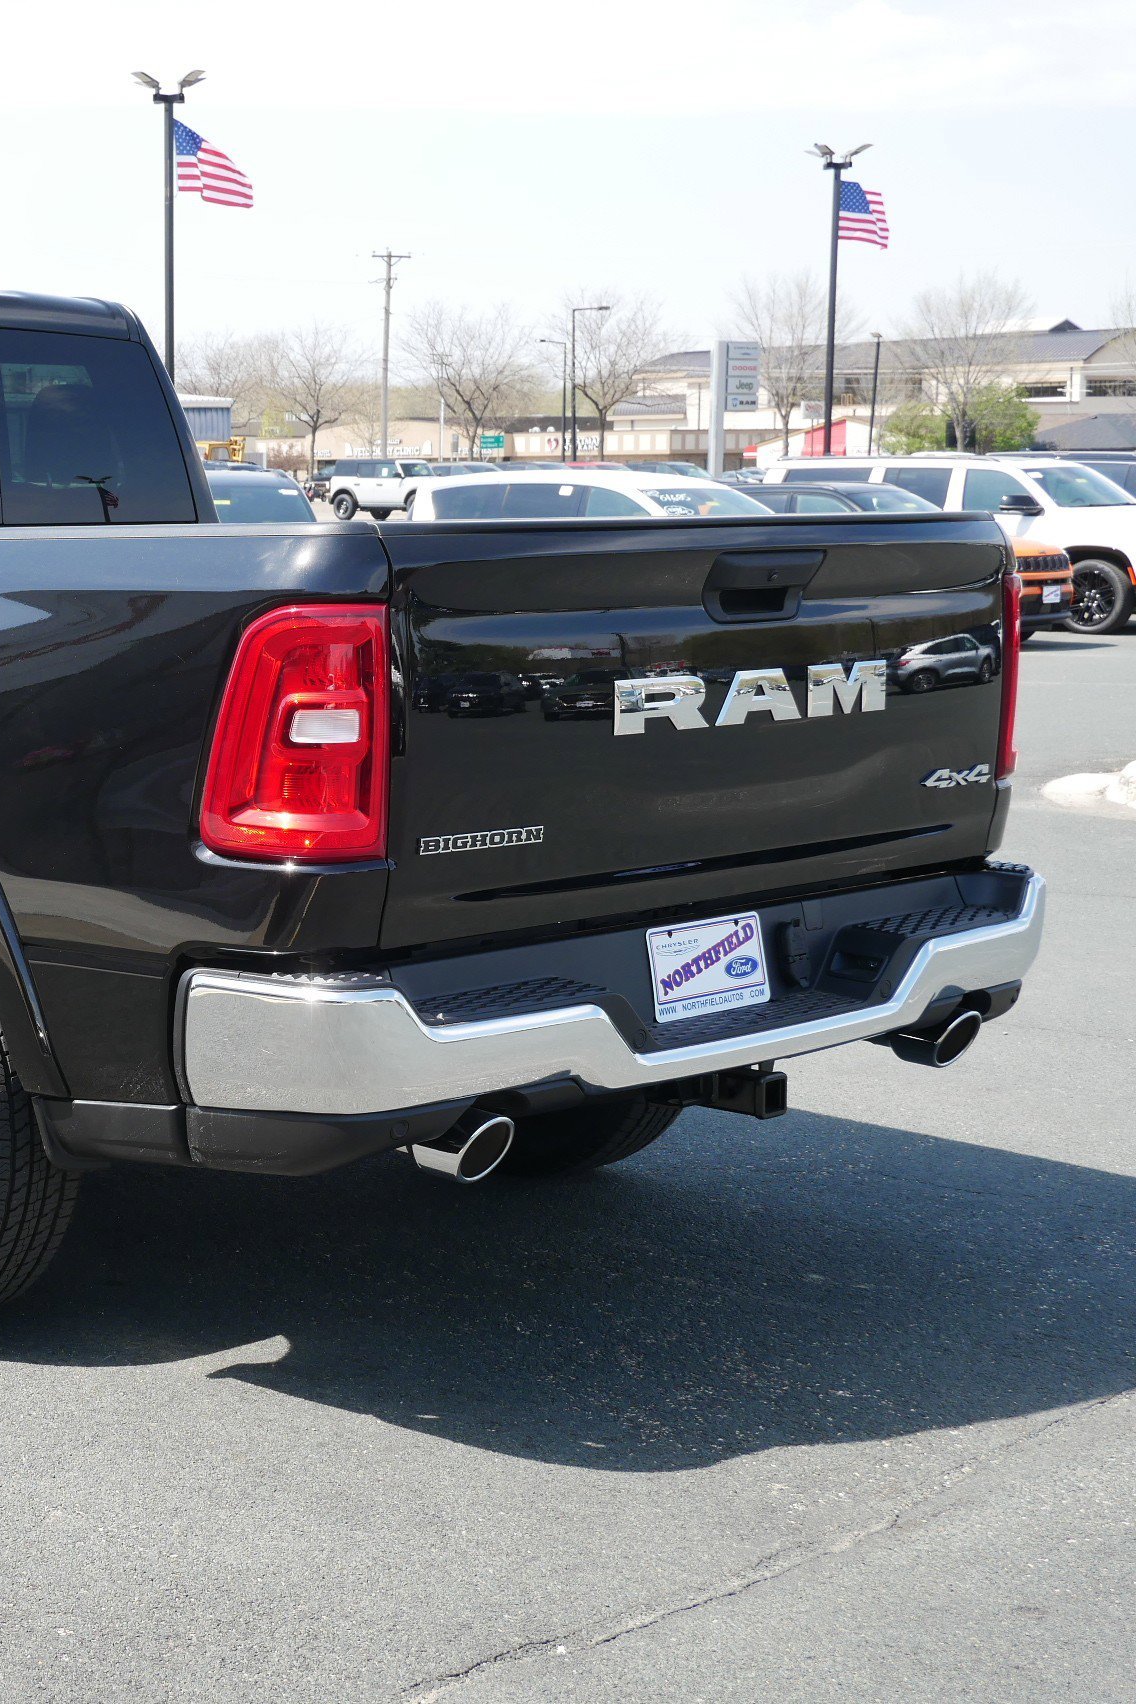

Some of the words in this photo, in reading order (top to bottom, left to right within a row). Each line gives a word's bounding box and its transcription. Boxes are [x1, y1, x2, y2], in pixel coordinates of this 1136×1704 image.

[736, 380, 754, 391] Jeep
[394, 446, 420, 455] CLINIC
[613, 660, 887, 736] RAM
[419, 825, 544, 855] BIGHORN
[656, 938, 699, 950] CHRYSLER
[659, 922, 755, 997] NORTHFIELD
[730, 959, 752, 975] Ford
[682, 992, 744, 1012] NORTHFIELDAUTOS
